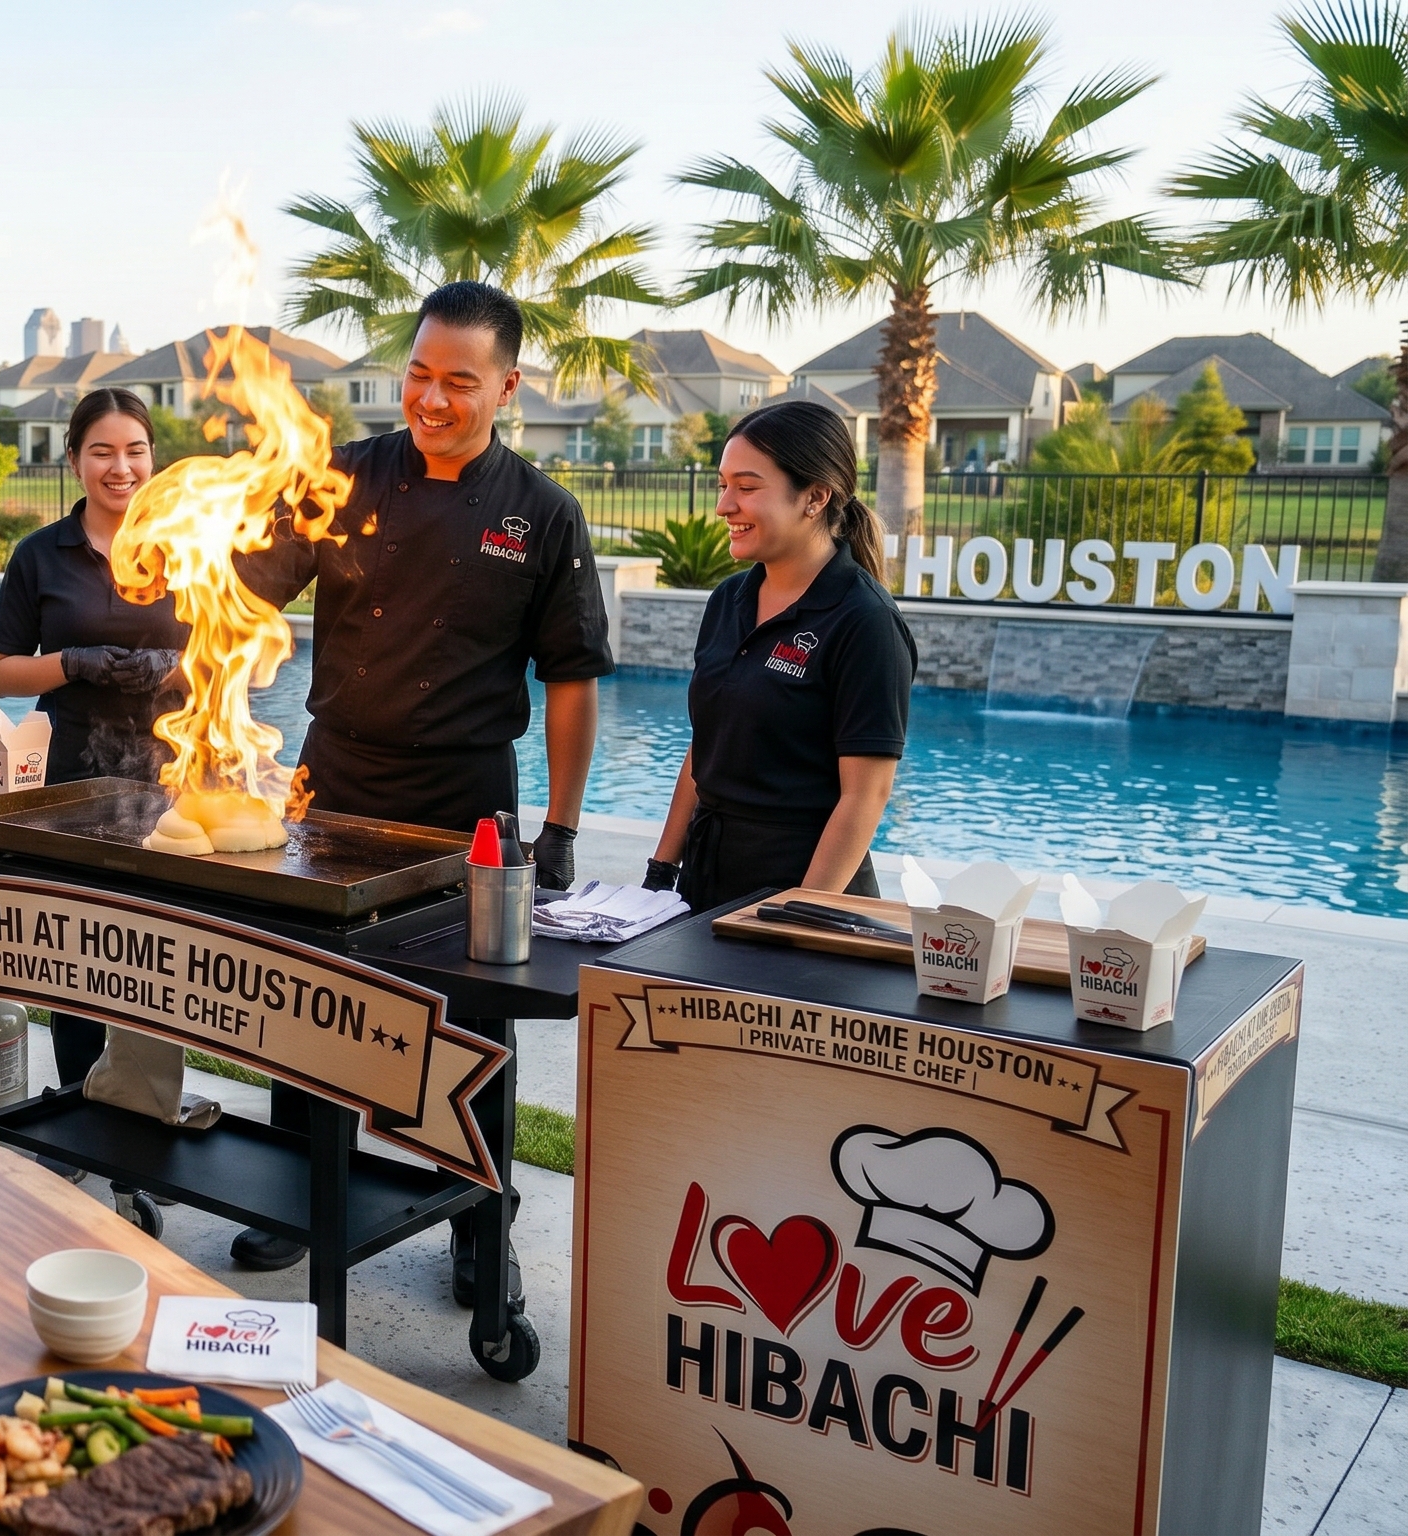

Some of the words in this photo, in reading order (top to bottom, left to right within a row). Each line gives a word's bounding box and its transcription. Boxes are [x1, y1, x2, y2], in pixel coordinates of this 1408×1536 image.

[32, 911, 72, 949] AT
[79, 920, 175, 977] HOME
[187, 952, 367, 1044] HOUSTON
[922, 951, 978, 972] HIBACHI
[1080, 974, 1138, 997] HIBACHI
[86, 966, 175, 1014] MOBILE
[183, 993, 249, 1037] CHEF
[680, 996, 782, 1028] HIBACHI
[789, 1007, 824, 1033] AT
[831, 1013, 908, 1053] HOME
[918, 1026, 1054, 1086] HOUSTON
[749, 1028, 826, 1057] PRIVATE
[832, 1040, 907, 1074] MOBILE
[913, 1058, 966, 1086] CHEF
[186, 1339, 271, 1355] HIBACHI
[667, 1313, 1035, 1497] HIBACHI
